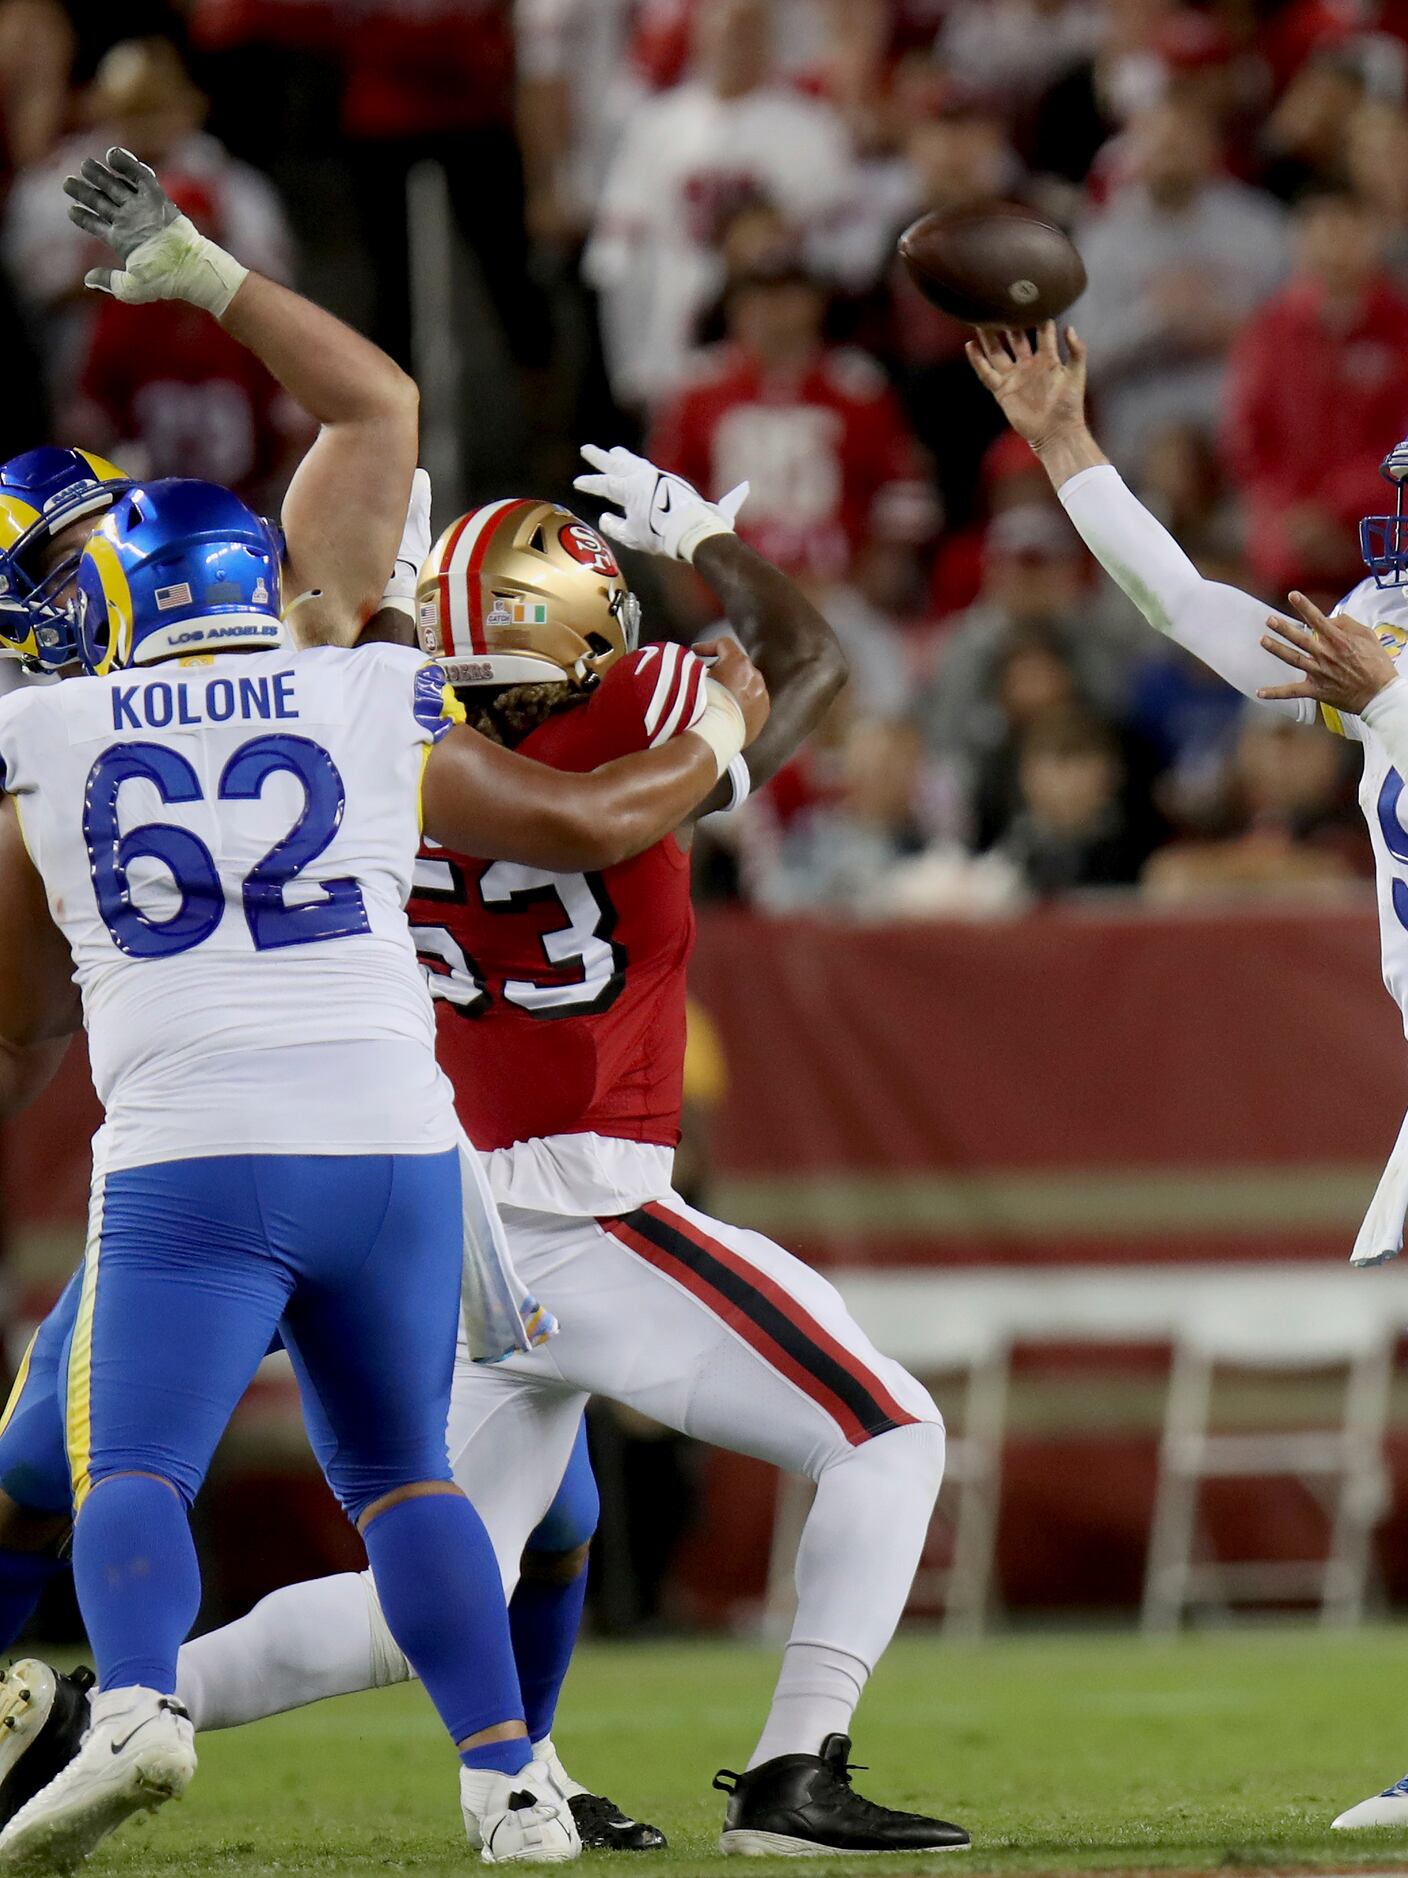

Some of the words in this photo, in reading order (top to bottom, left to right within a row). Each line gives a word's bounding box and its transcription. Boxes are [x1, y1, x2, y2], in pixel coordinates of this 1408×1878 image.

[167, 630, 204, 646] LOS
[207, 626, 278, 639] ANGELES
[446, 662, 494, 681] 9ERS
[111, 670, 299, 730] KOLONE
[83, 732, 373, 959] 62
